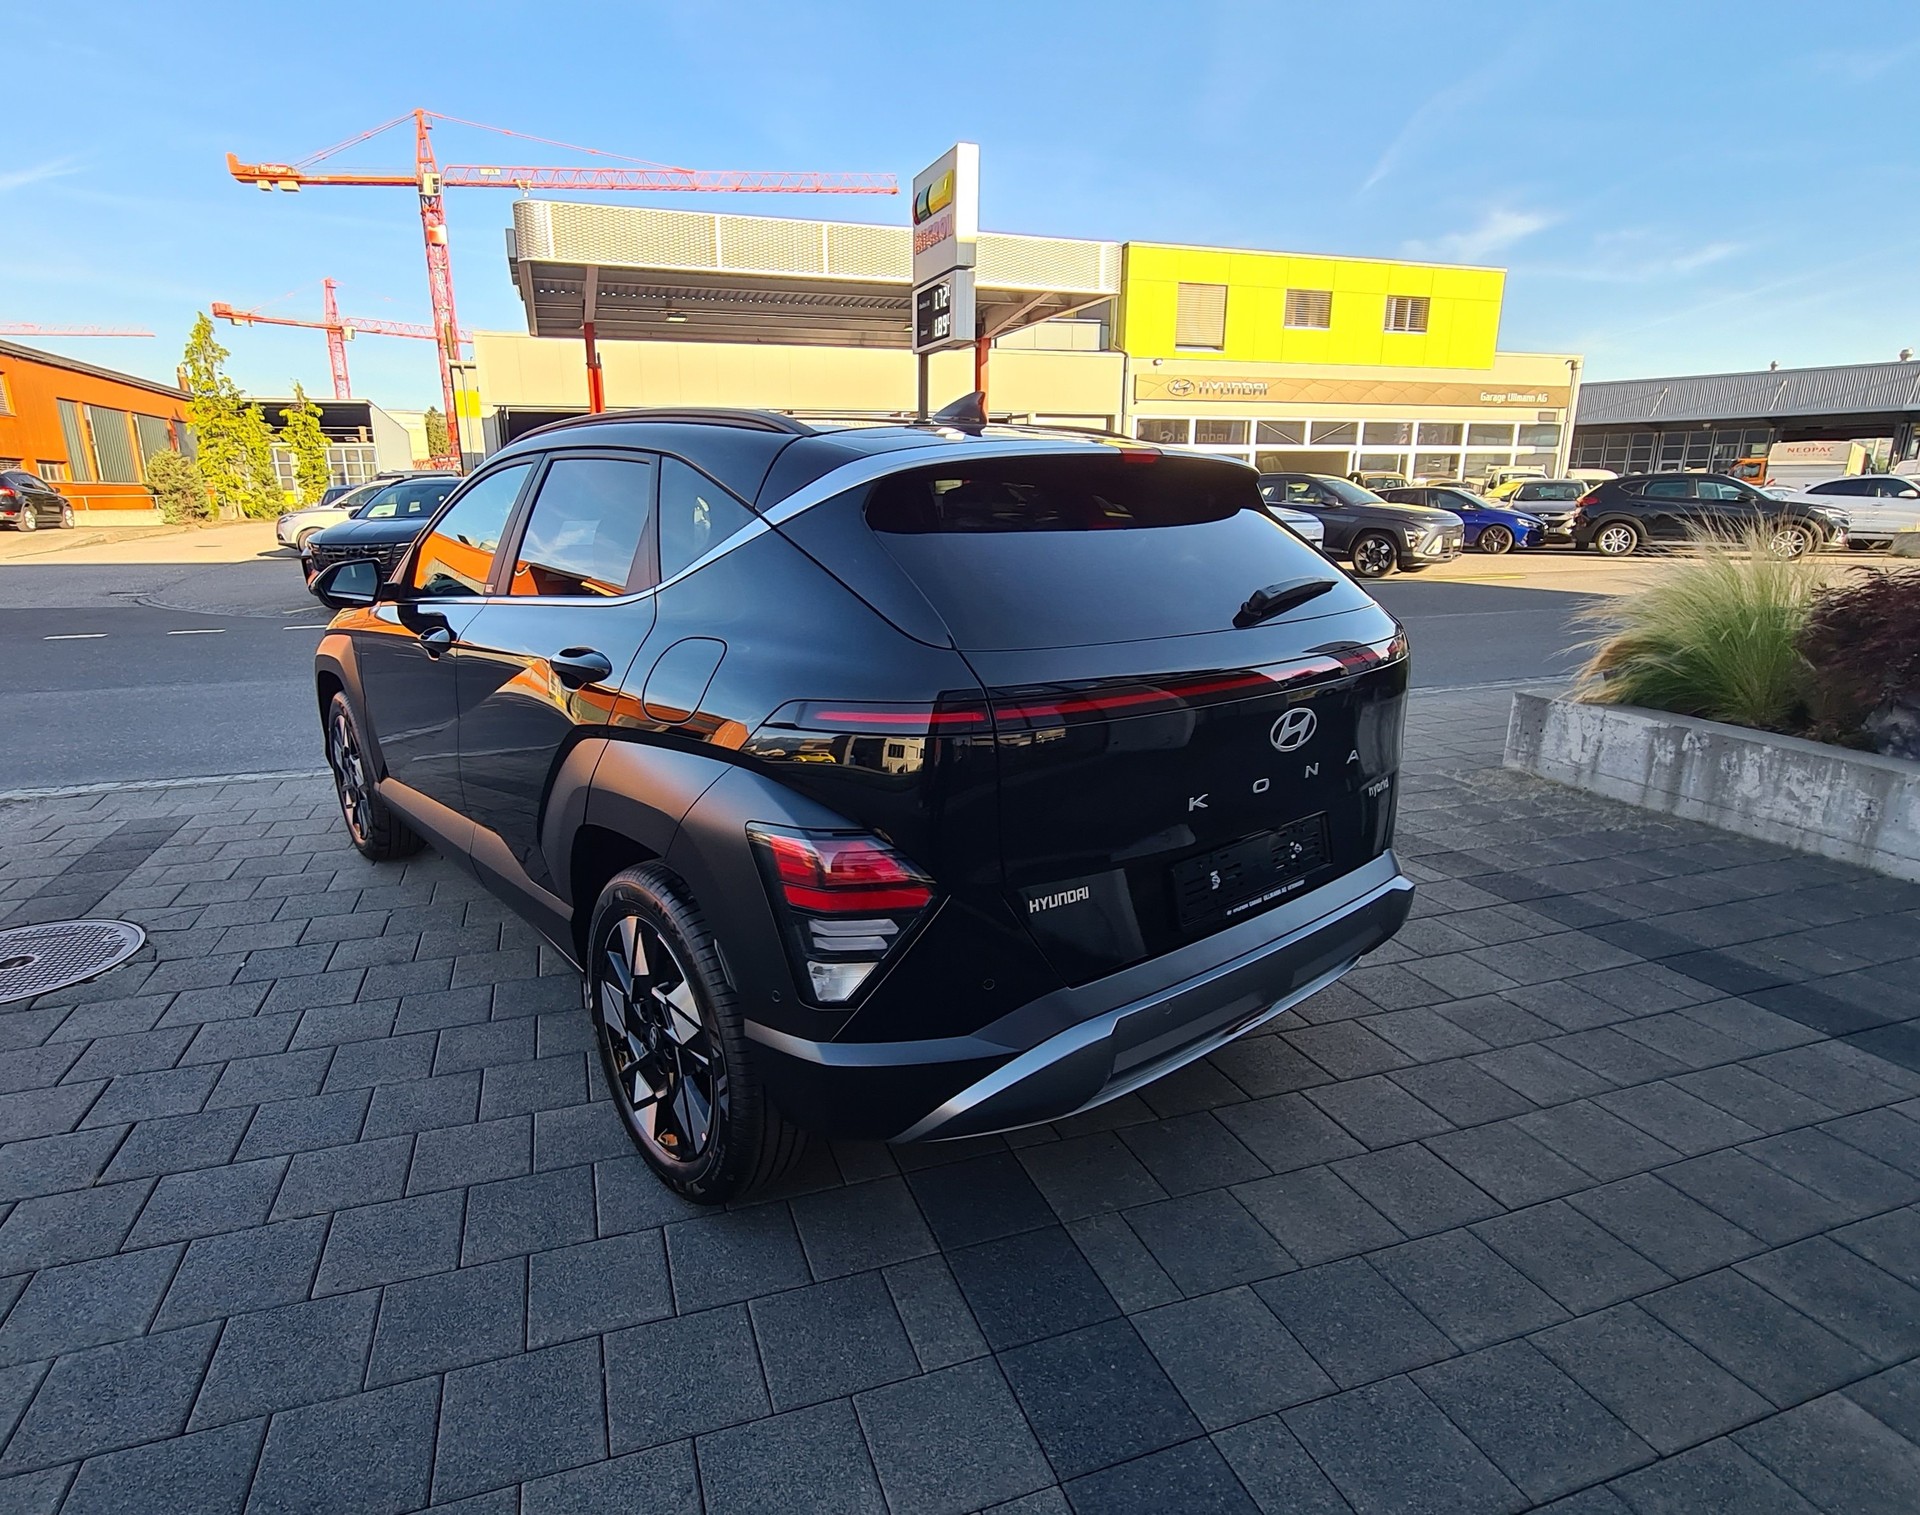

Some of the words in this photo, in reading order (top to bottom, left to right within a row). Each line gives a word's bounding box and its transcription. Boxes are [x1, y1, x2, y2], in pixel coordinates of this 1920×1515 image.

[1198, 381, 1269, 396] HYUNDAI
[1480, 392, 1507, 404] Garage
[1507, 392, 1536, 403] Ullmann
[1536, 393, 1549, 403] AG
[1188, 749, 1360, 812] KONA
[1028, 886, 1090, 914] HYUNDAI
